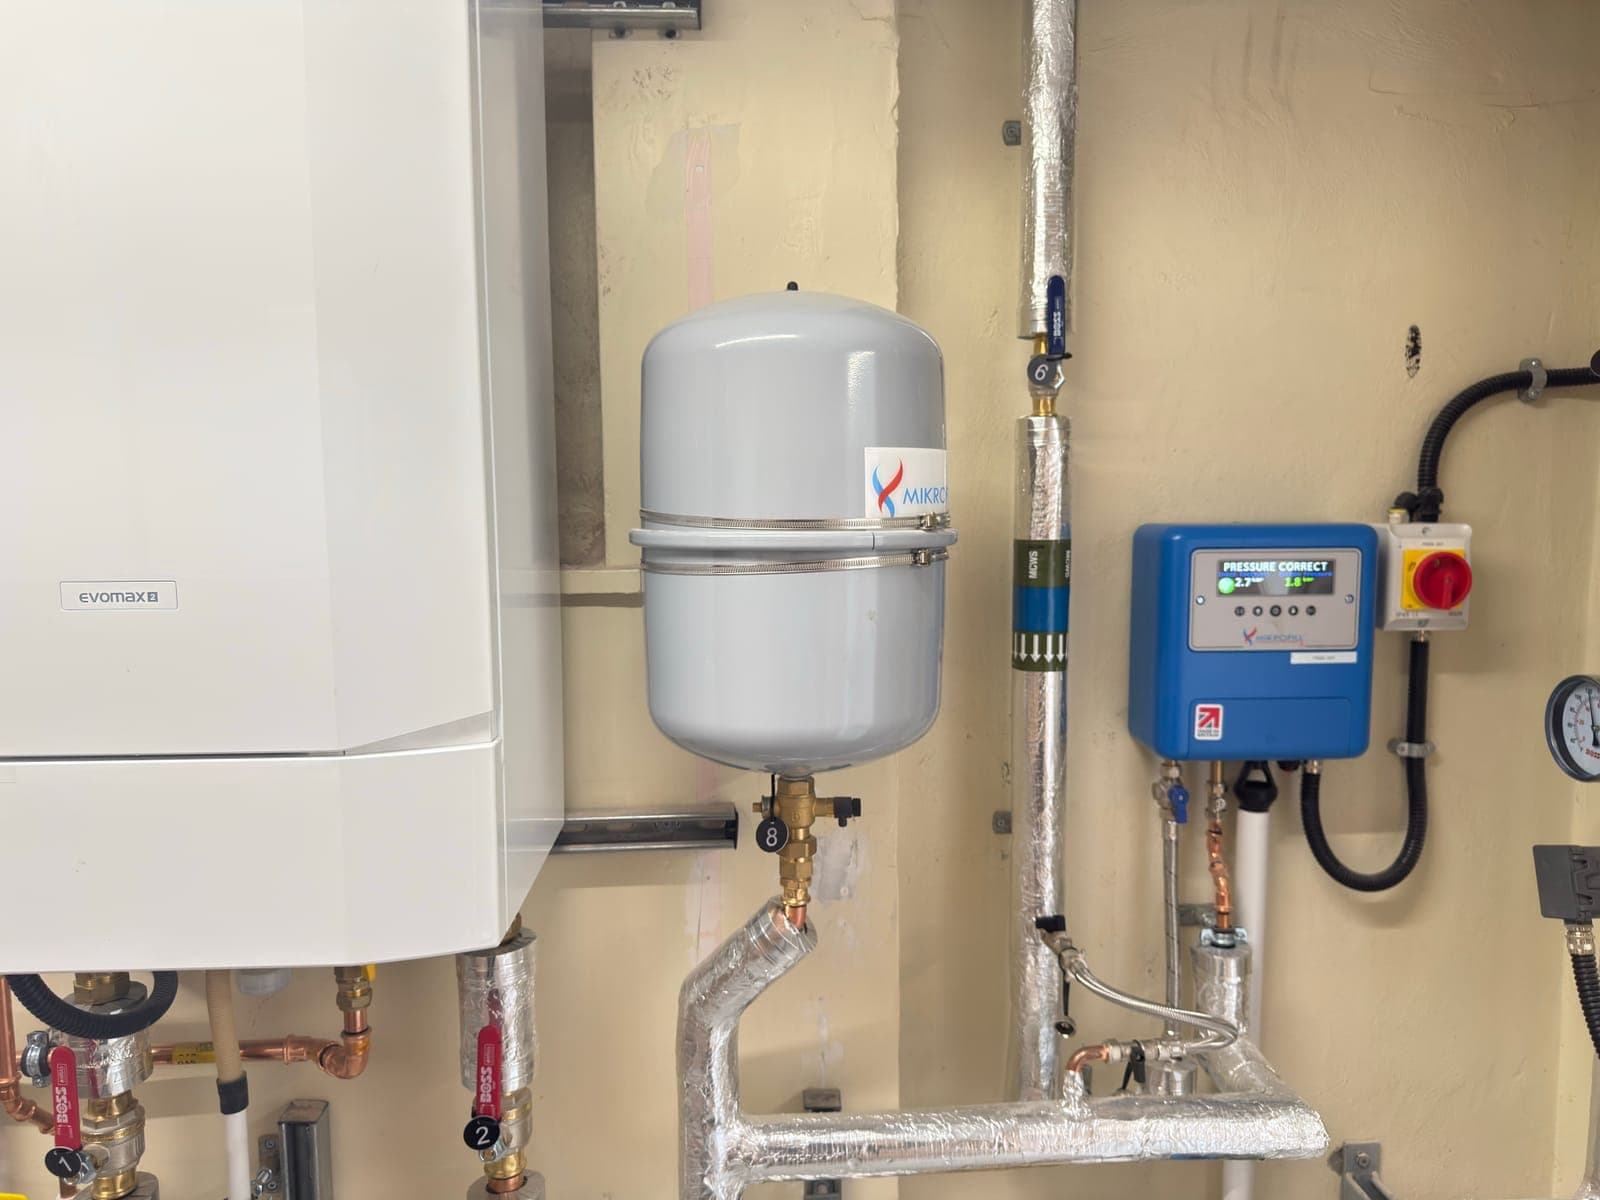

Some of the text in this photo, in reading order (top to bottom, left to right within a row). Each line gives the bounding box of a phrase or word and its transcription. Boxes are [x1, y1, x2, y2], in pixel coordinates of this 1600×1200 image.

[1035, 364, 1048, 381] 6
[1028, 550, 1038, 579] MCWS
[1223, 561, 1328, 572] PRESSURE CORRECT
[79, 592, 145, 603] evomax
[766, 827, 778, 846] 8
[480, 1066, 492, 1103] BOSS
[55, 1086, 68, 1123] BOSS
[475, 1126, 490, 1145] 2
